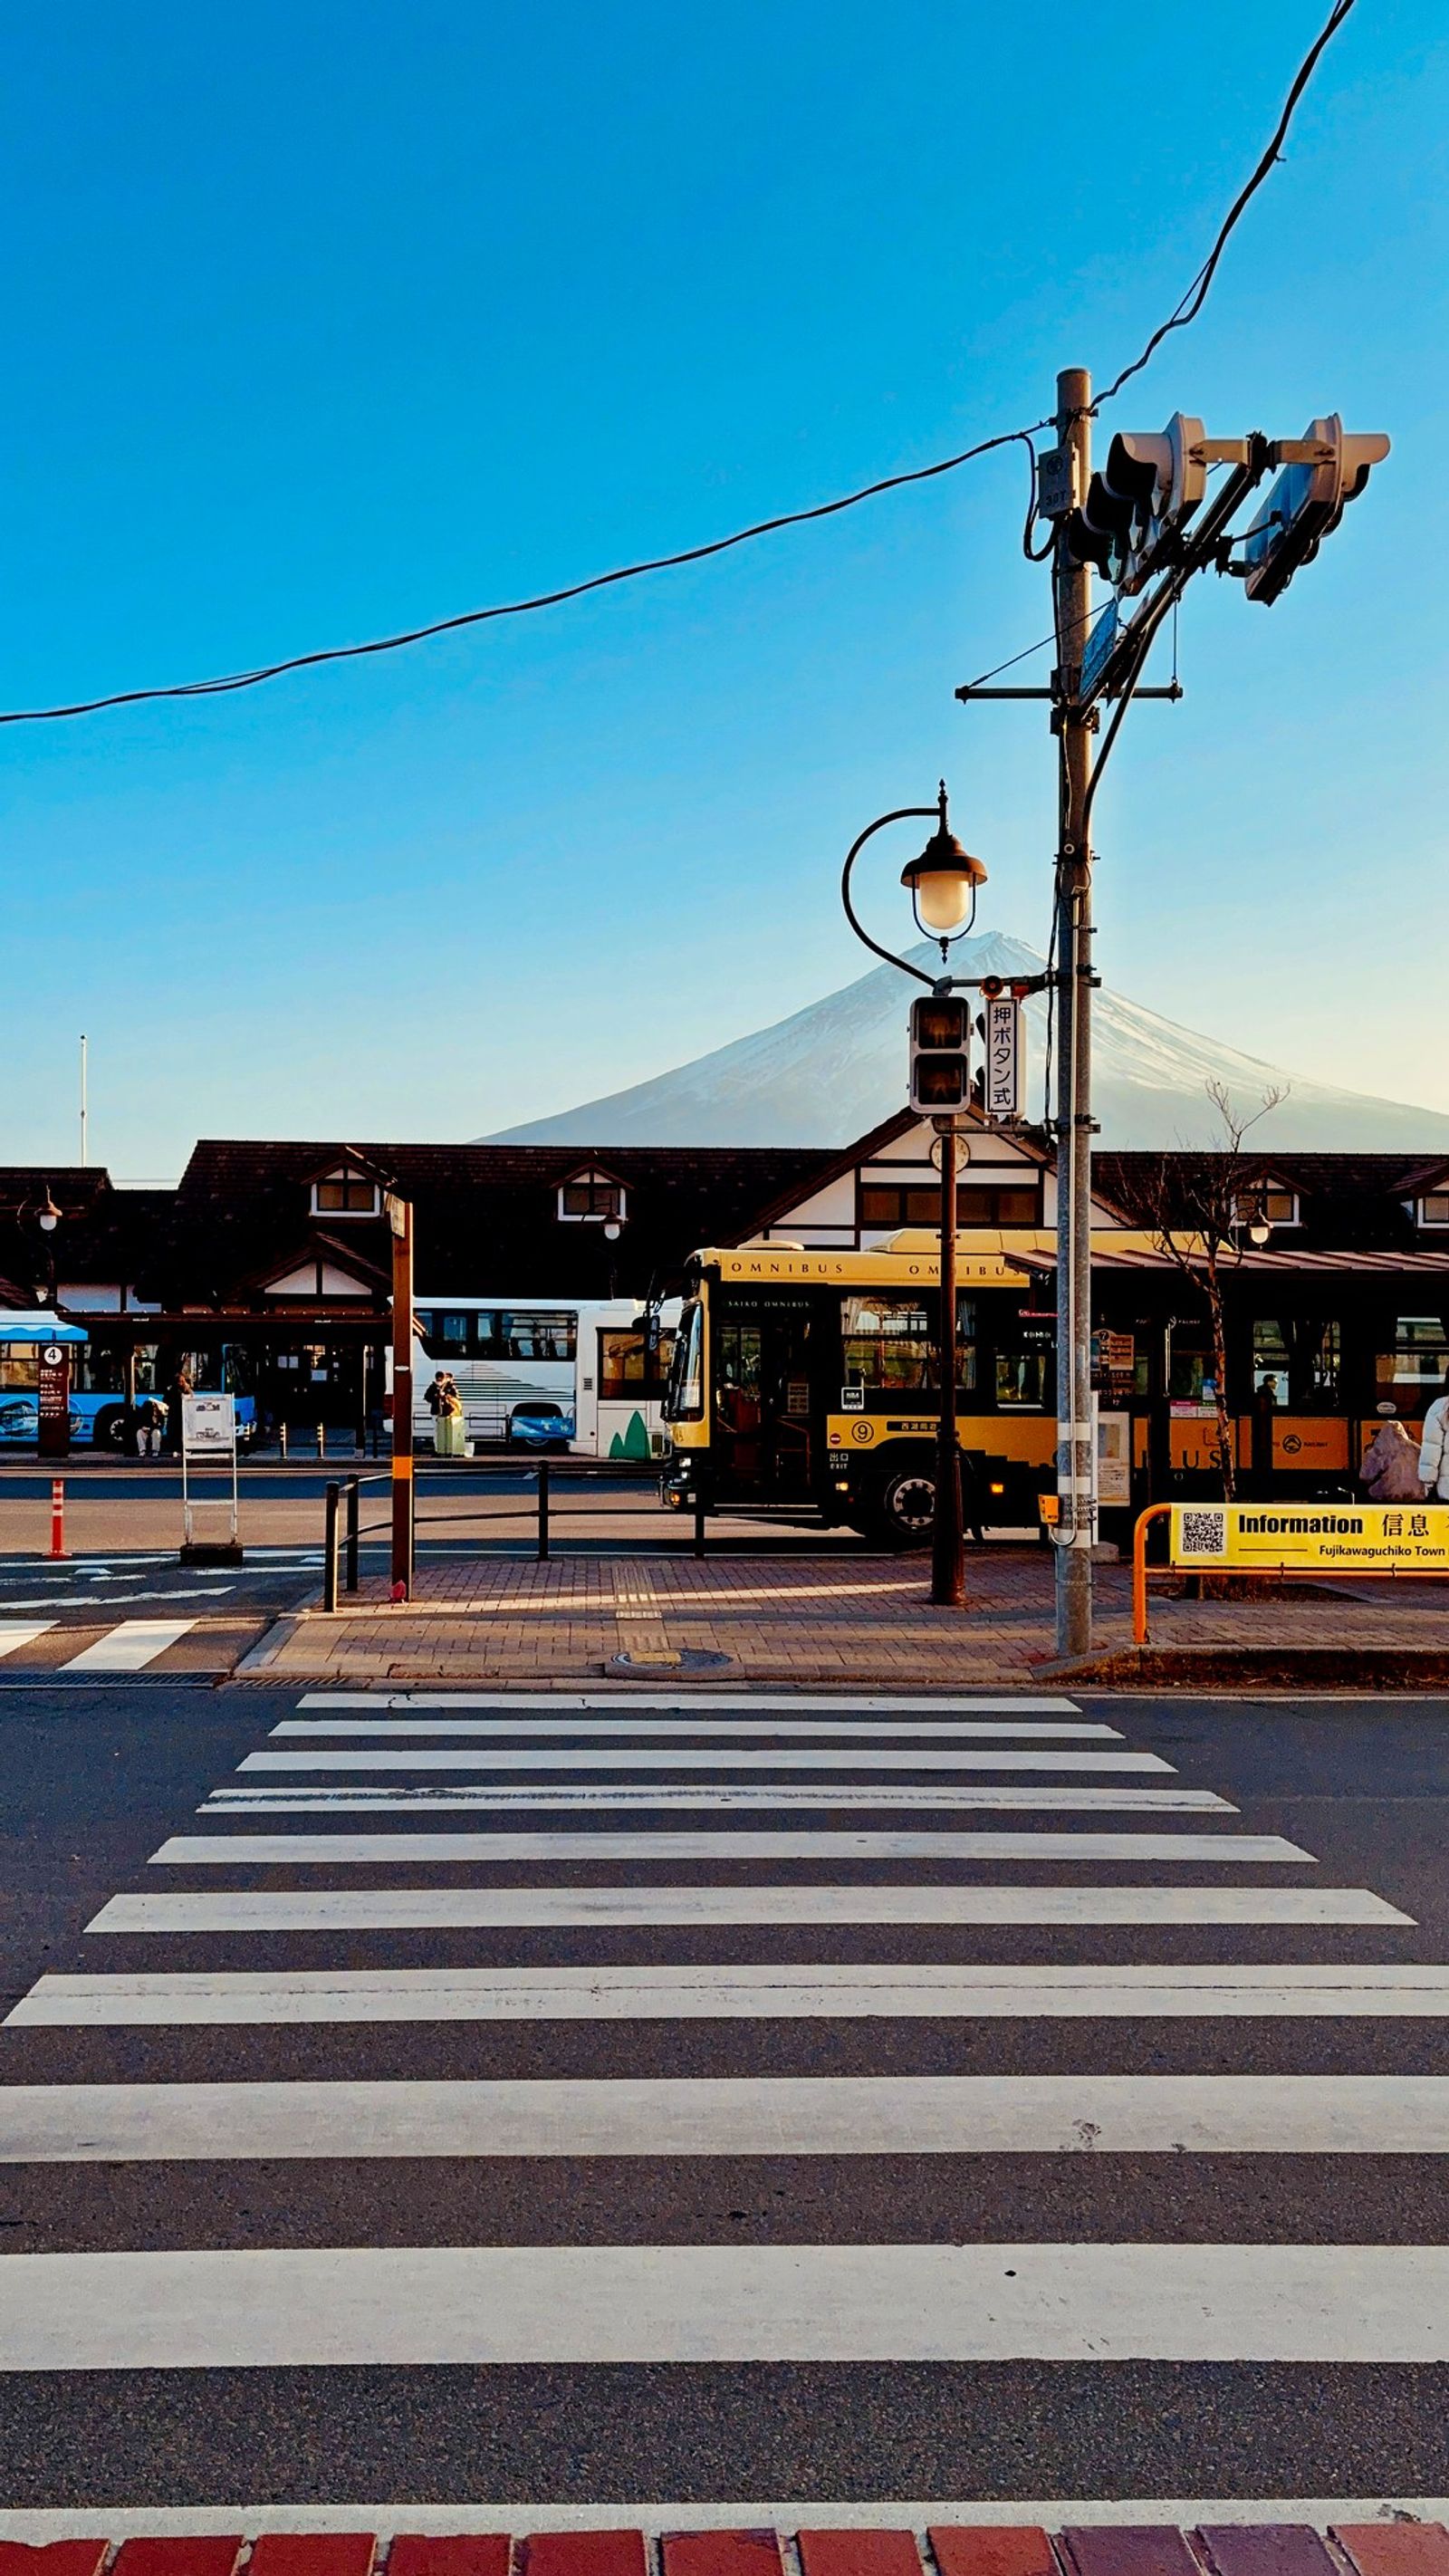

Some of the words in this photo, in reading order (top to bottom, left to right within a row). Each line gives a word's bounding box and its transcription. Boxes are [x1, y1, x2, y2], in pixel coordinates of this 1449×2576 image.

[993, 1006, 1012, 1105] 押ボタン式
[731, 1262, 842, 1274] OMNIBUS
[48, 1349, 56, 1360] 4
[857, 1425, 868, 1440] 9
[829, 1453, 849, 1462] 出口
[1238, 1514, 1363, 1534] Information
[1382, 1514, 1429, 1537] 信息
[1319, 1544, 1412, 1559] Fujikawaguchiko
[1415, 1545, 1445, 1557] Town
